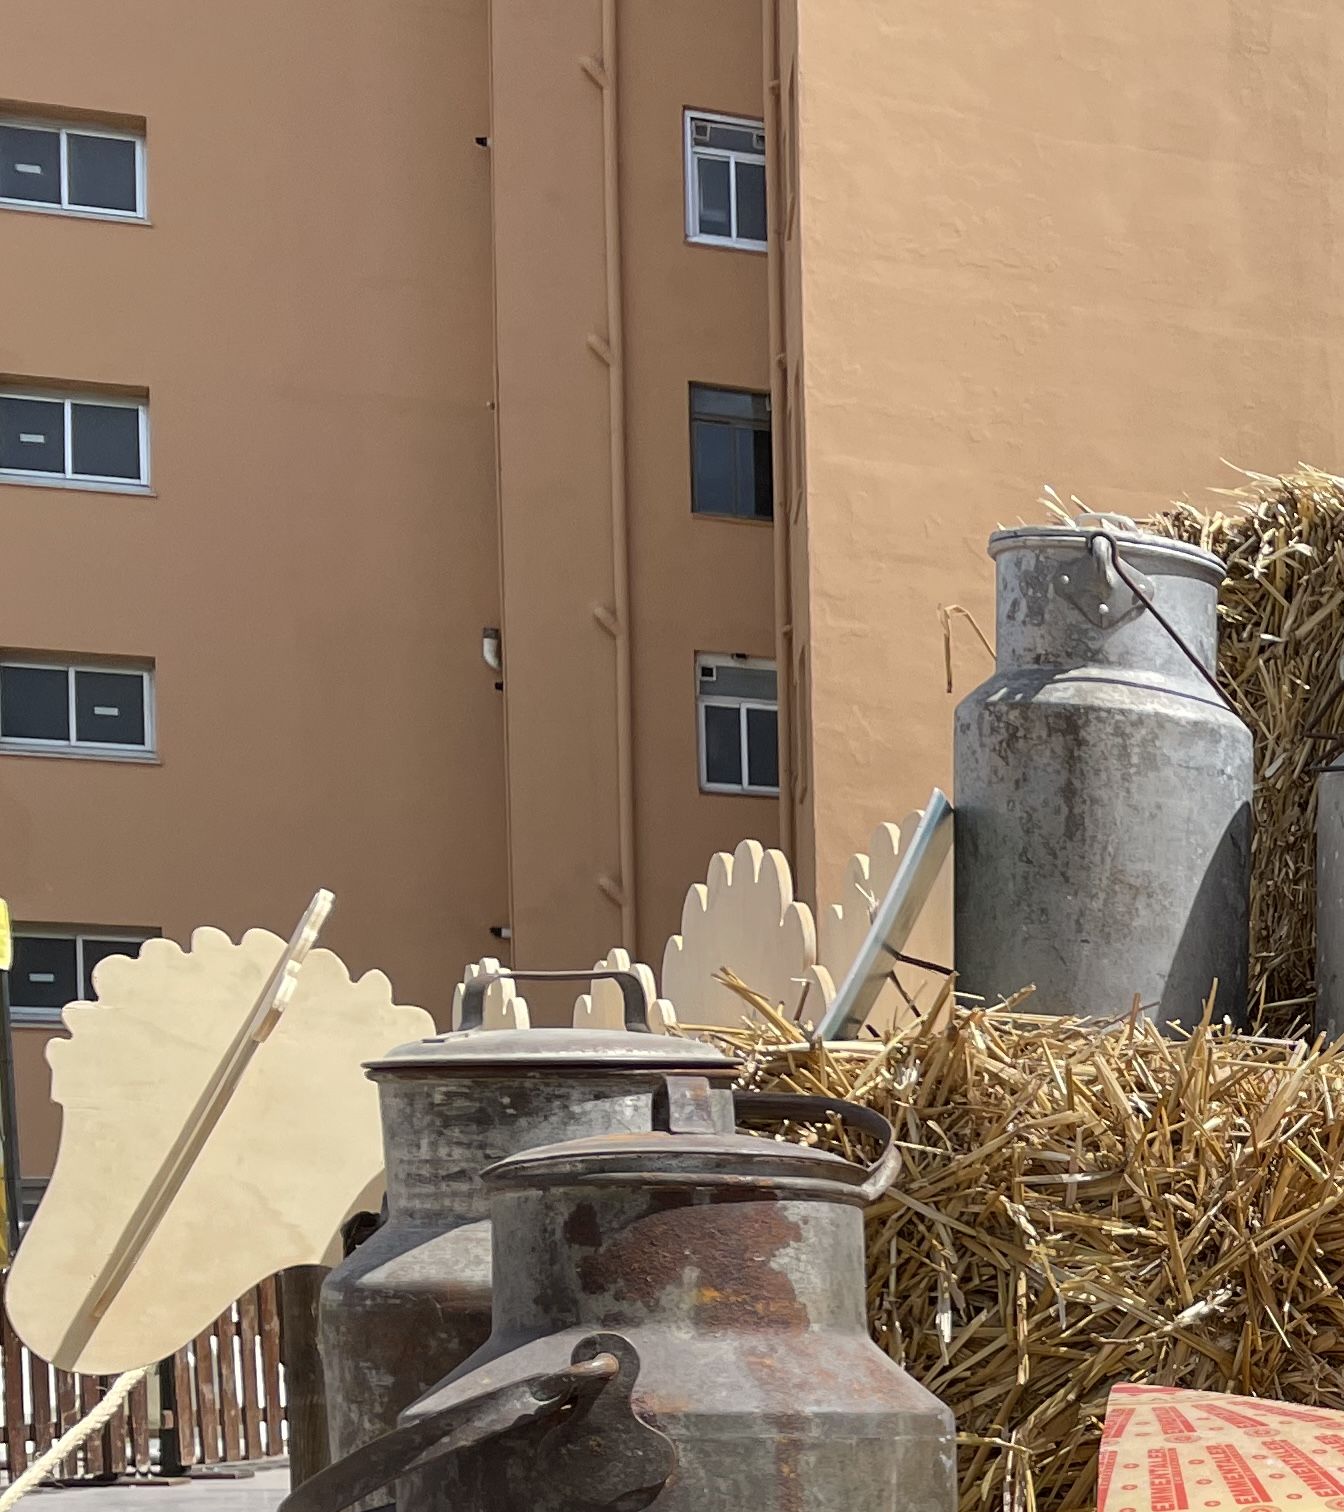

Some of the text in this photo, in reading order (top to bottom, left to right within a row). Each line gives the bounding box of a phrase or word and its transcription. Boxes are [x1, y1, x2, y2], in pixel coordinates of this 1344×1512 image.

[1146, 1447, 1176, 1512] EMMENTALER
[1206, 1444, 1261, 1505] EMMENTALER
[1261, 1440, 1342, 1498] EMMENTALER
